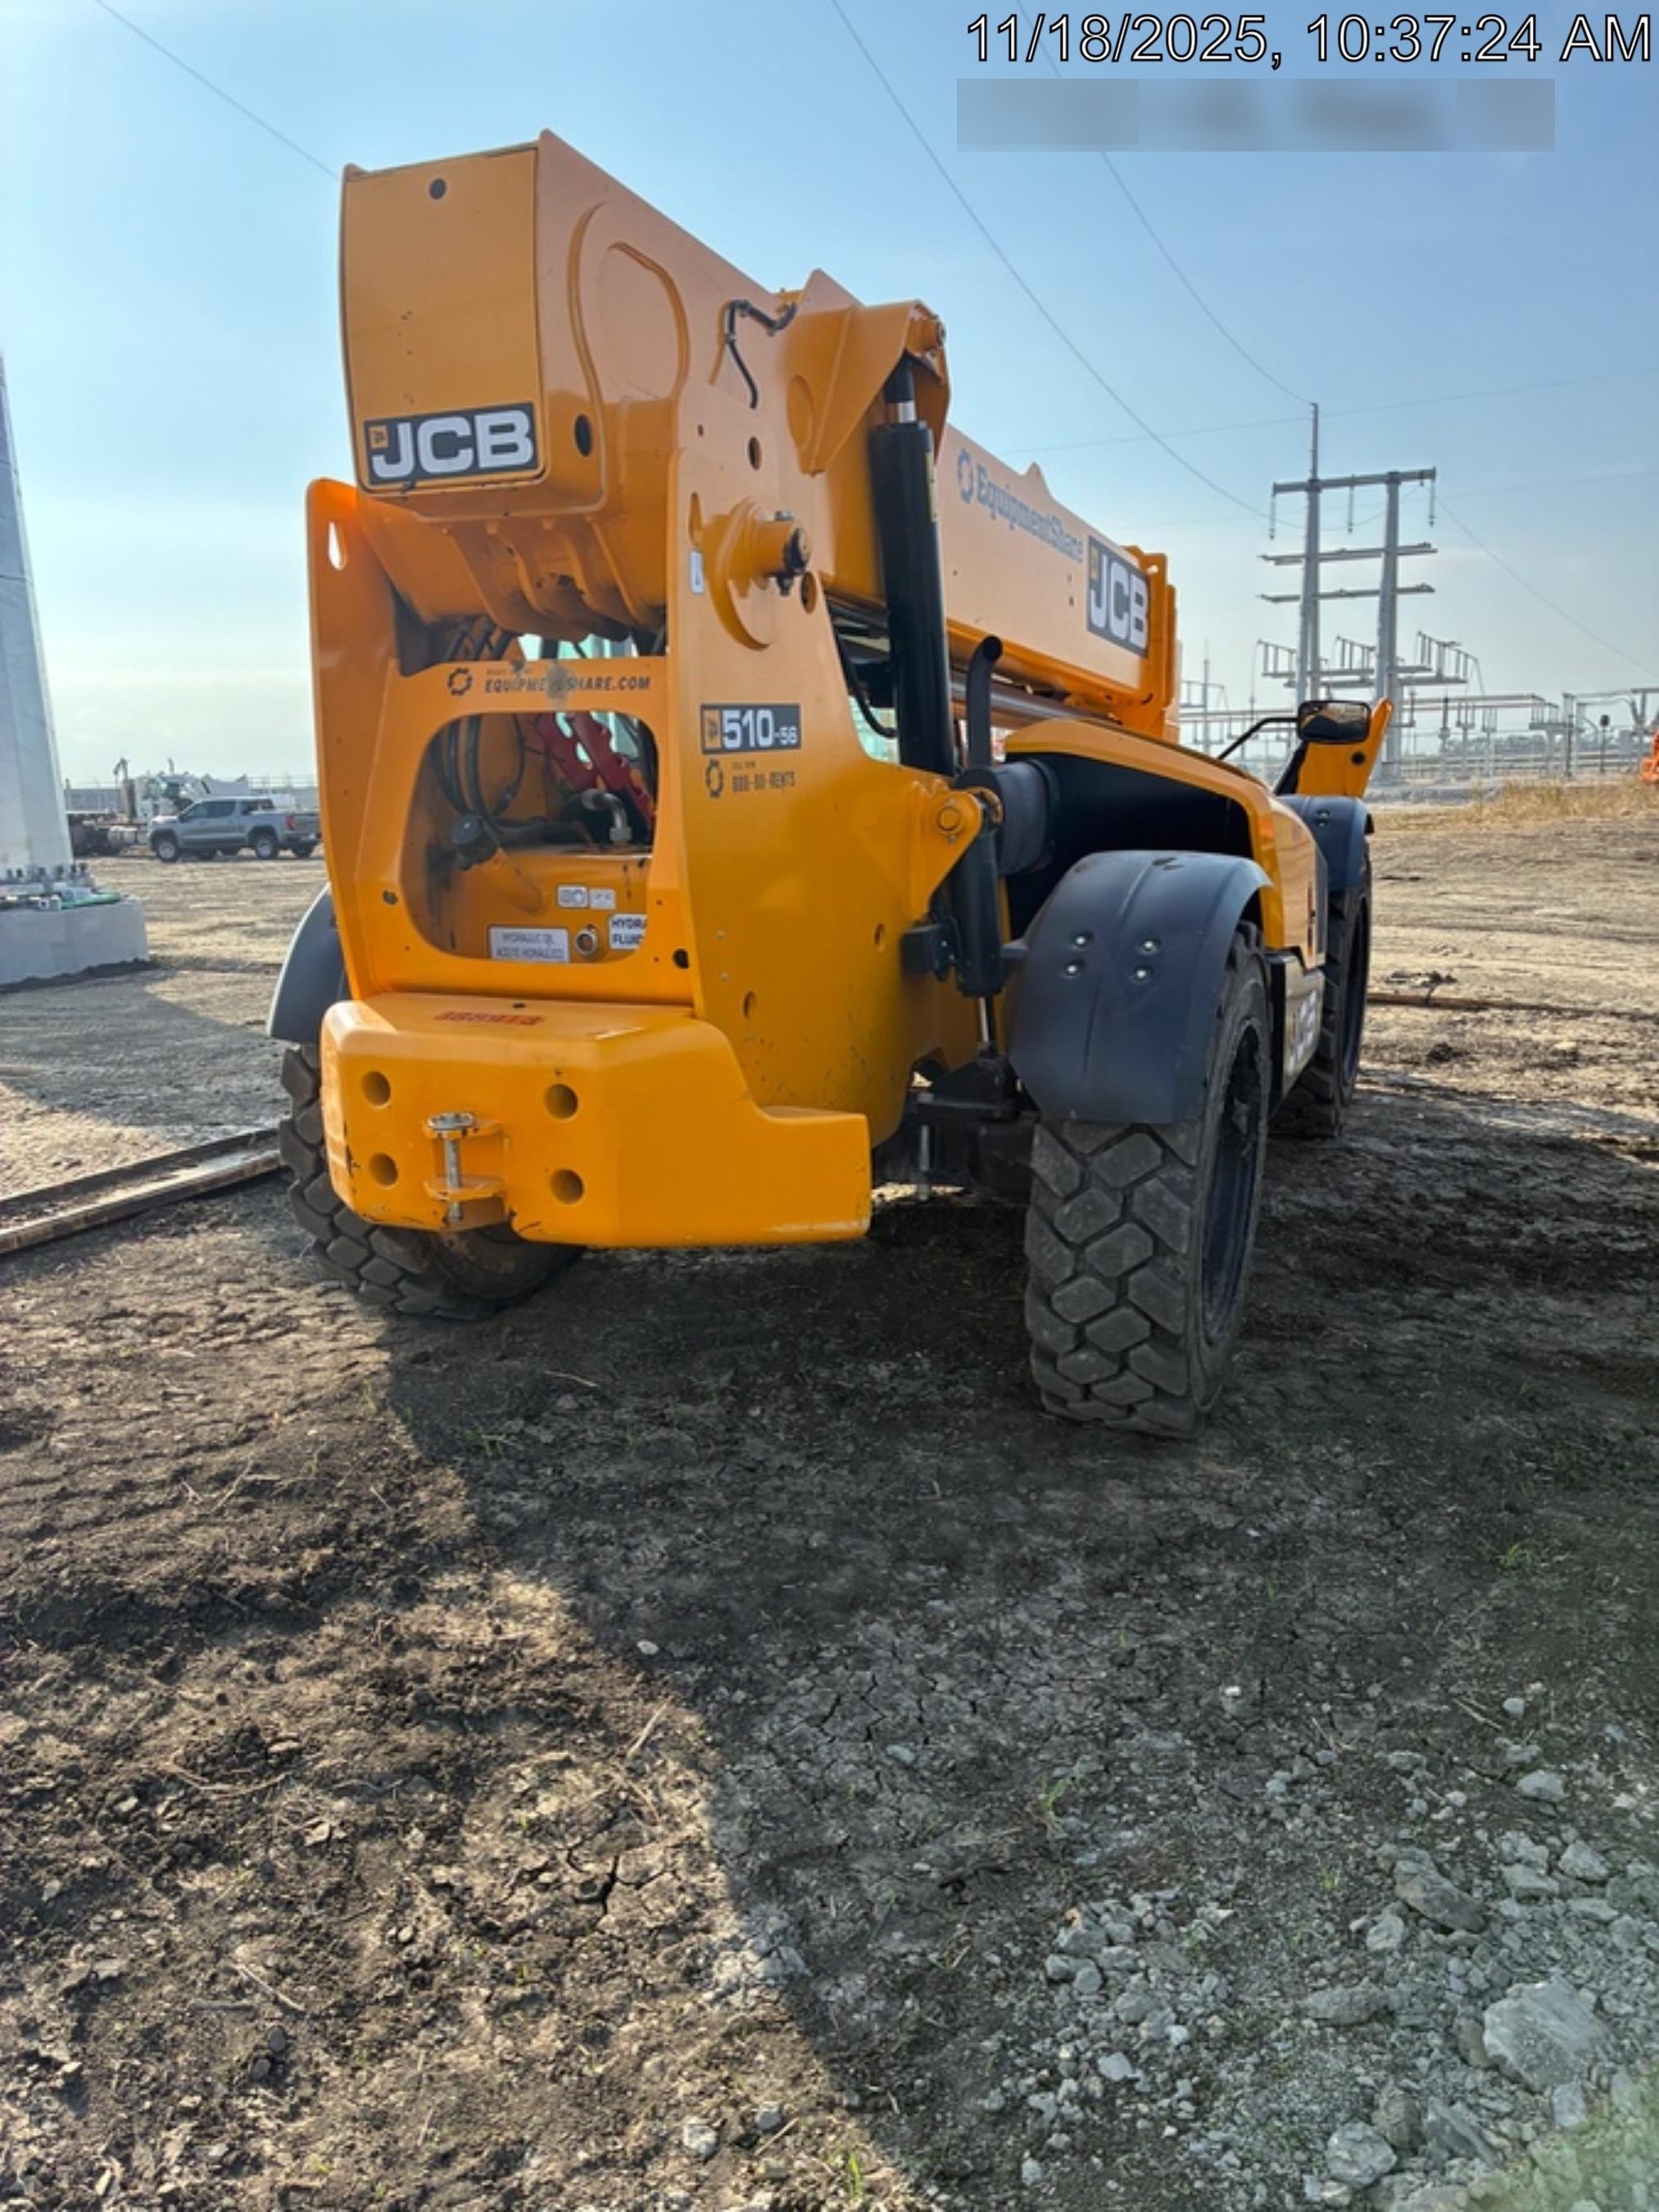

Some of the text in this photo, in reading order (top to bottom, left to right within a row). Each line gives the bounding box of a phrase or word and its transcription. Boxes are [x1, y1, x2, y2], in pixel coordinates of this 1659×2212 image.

[371, 410, 534, 478] JCB
[977, 464, 1083, 564] EquipmentShare
[1090, 553, 1149, 650] JCB
[484, 675, 651, 694] EQUIPMESHARE.COM
